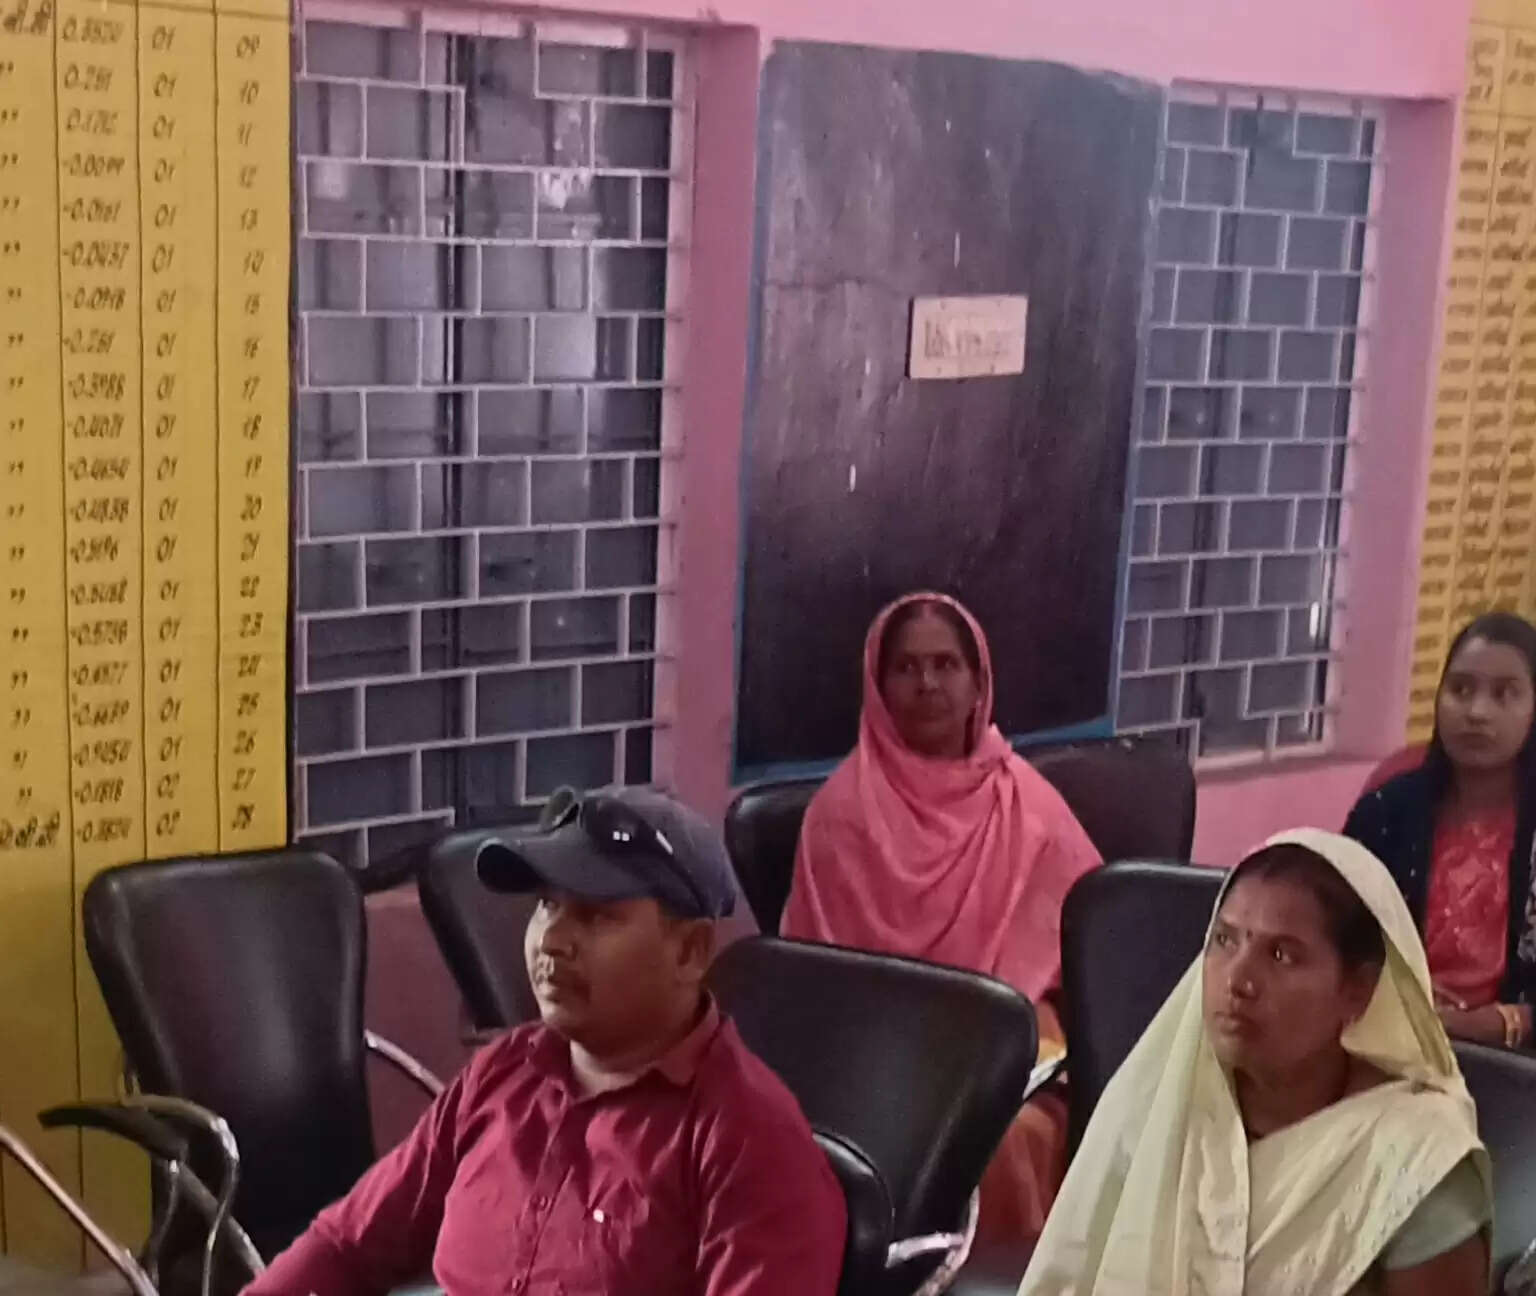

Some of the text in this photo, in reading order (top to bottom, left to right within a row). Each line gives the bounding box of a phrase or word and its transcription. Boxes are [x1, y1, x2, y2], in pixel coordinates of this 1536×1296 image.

[152, 26, 175, 50] 01
[236, 35, 260, 58] 09
[153, 72, 176, 97] 01
[240, 80, 259, 104] 10
[153, 115, 175, 139] 01
[238, 123, 252, 146] 11
[154, 159, 175, 183] 01
[155, 203, 176, 229] 01
[152, 244, 174, 274] 01
[156, 289, 176, 313] 01
[157, 333, 176, 358] 01
[157, 373, 175, 400] 01
[156, 415, 176, 439] 01
[243, 415, 261, 440] 18
[157, 456, 177, 480] 01
[159, 497, 177, 522] 01
[240, 494, 261, 522] 20
[157, 536, 176, 563] 01
[161, 580, 180, 602] 01
[160, 617, 180, 642] 01
[160, 660, 181, 684] 01
[161, 697, 181, 723] 01
[160, 736, 182, 762] 01
